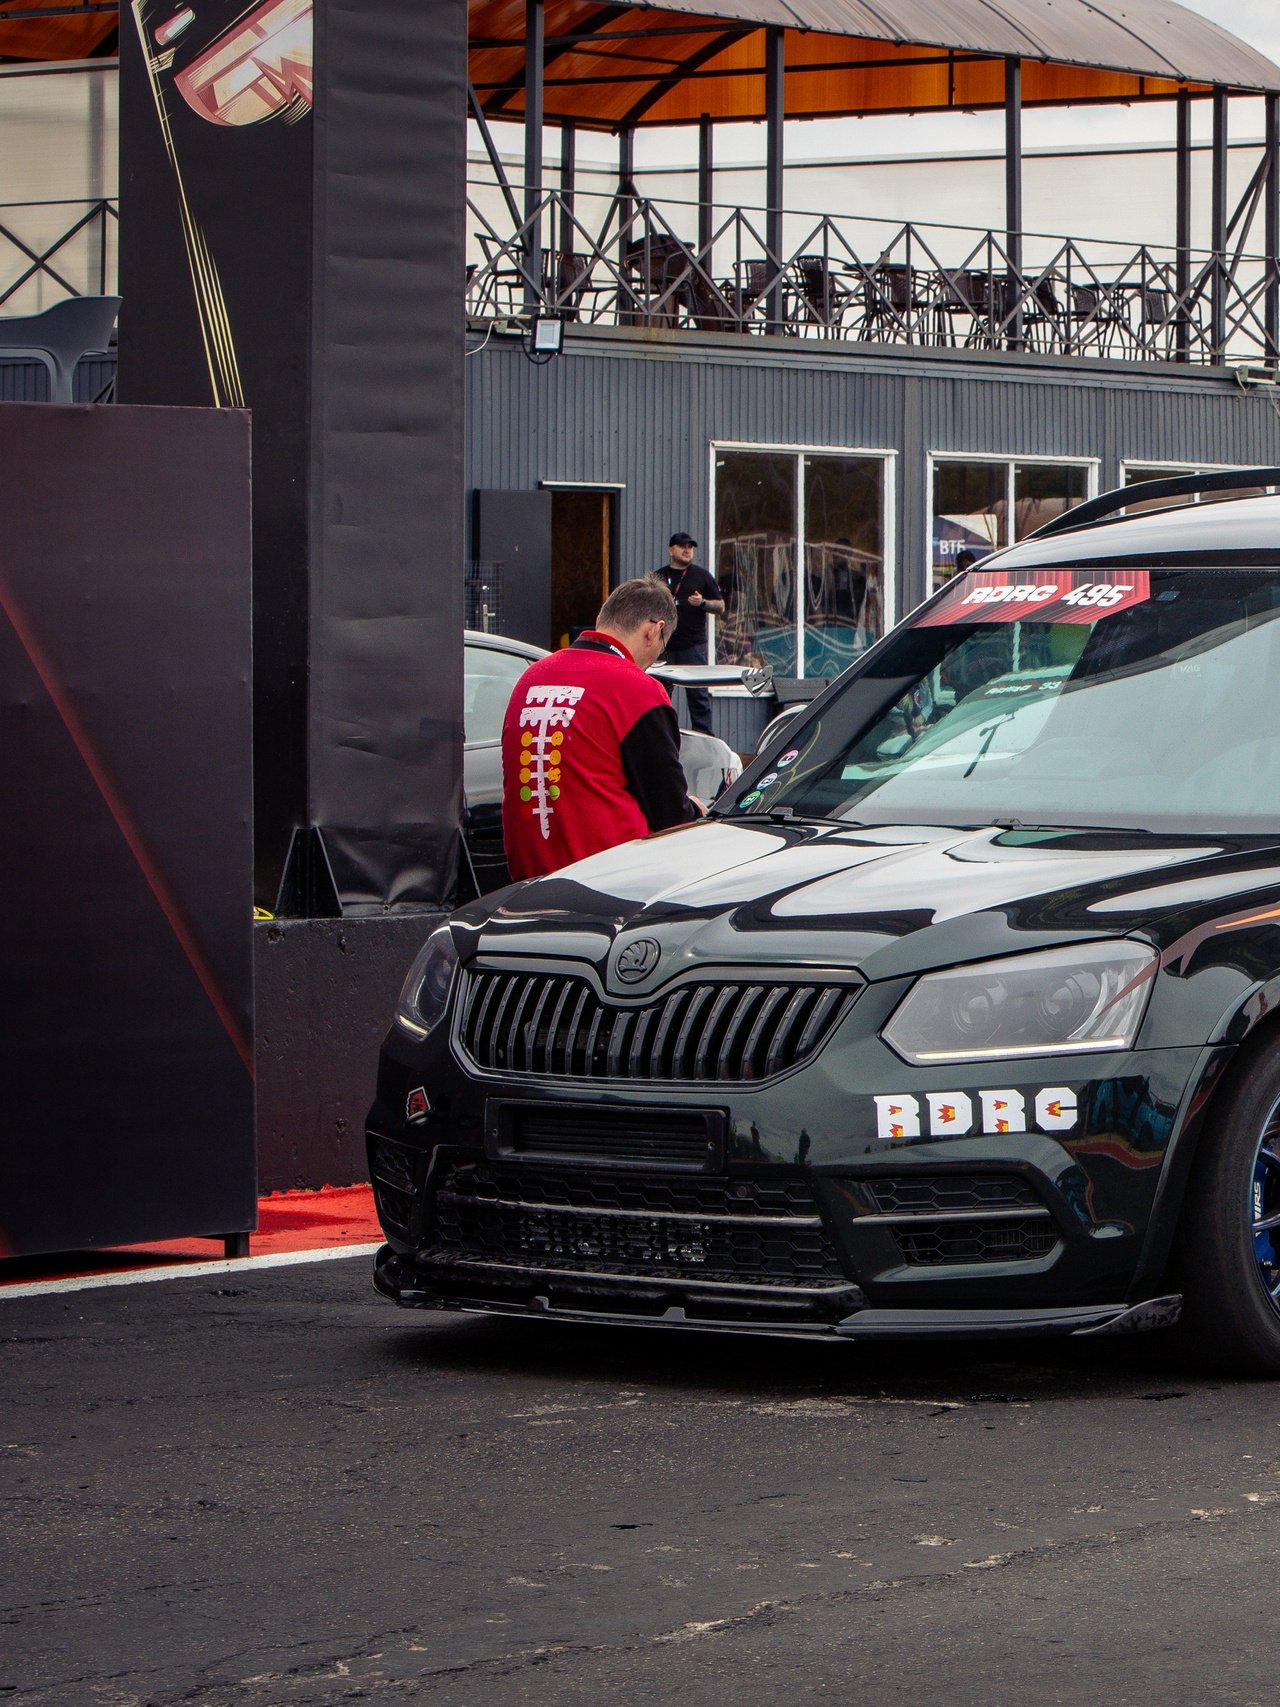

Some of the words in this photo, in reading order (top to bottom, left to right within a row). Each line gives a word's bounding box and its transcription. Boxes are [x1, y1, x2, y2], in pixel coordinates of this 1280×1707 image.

[961, 584, 1058, 604] RDRC
[1061, 583, 1134, 607] 495
[873, 1087, 1078, 1139] RDRC
